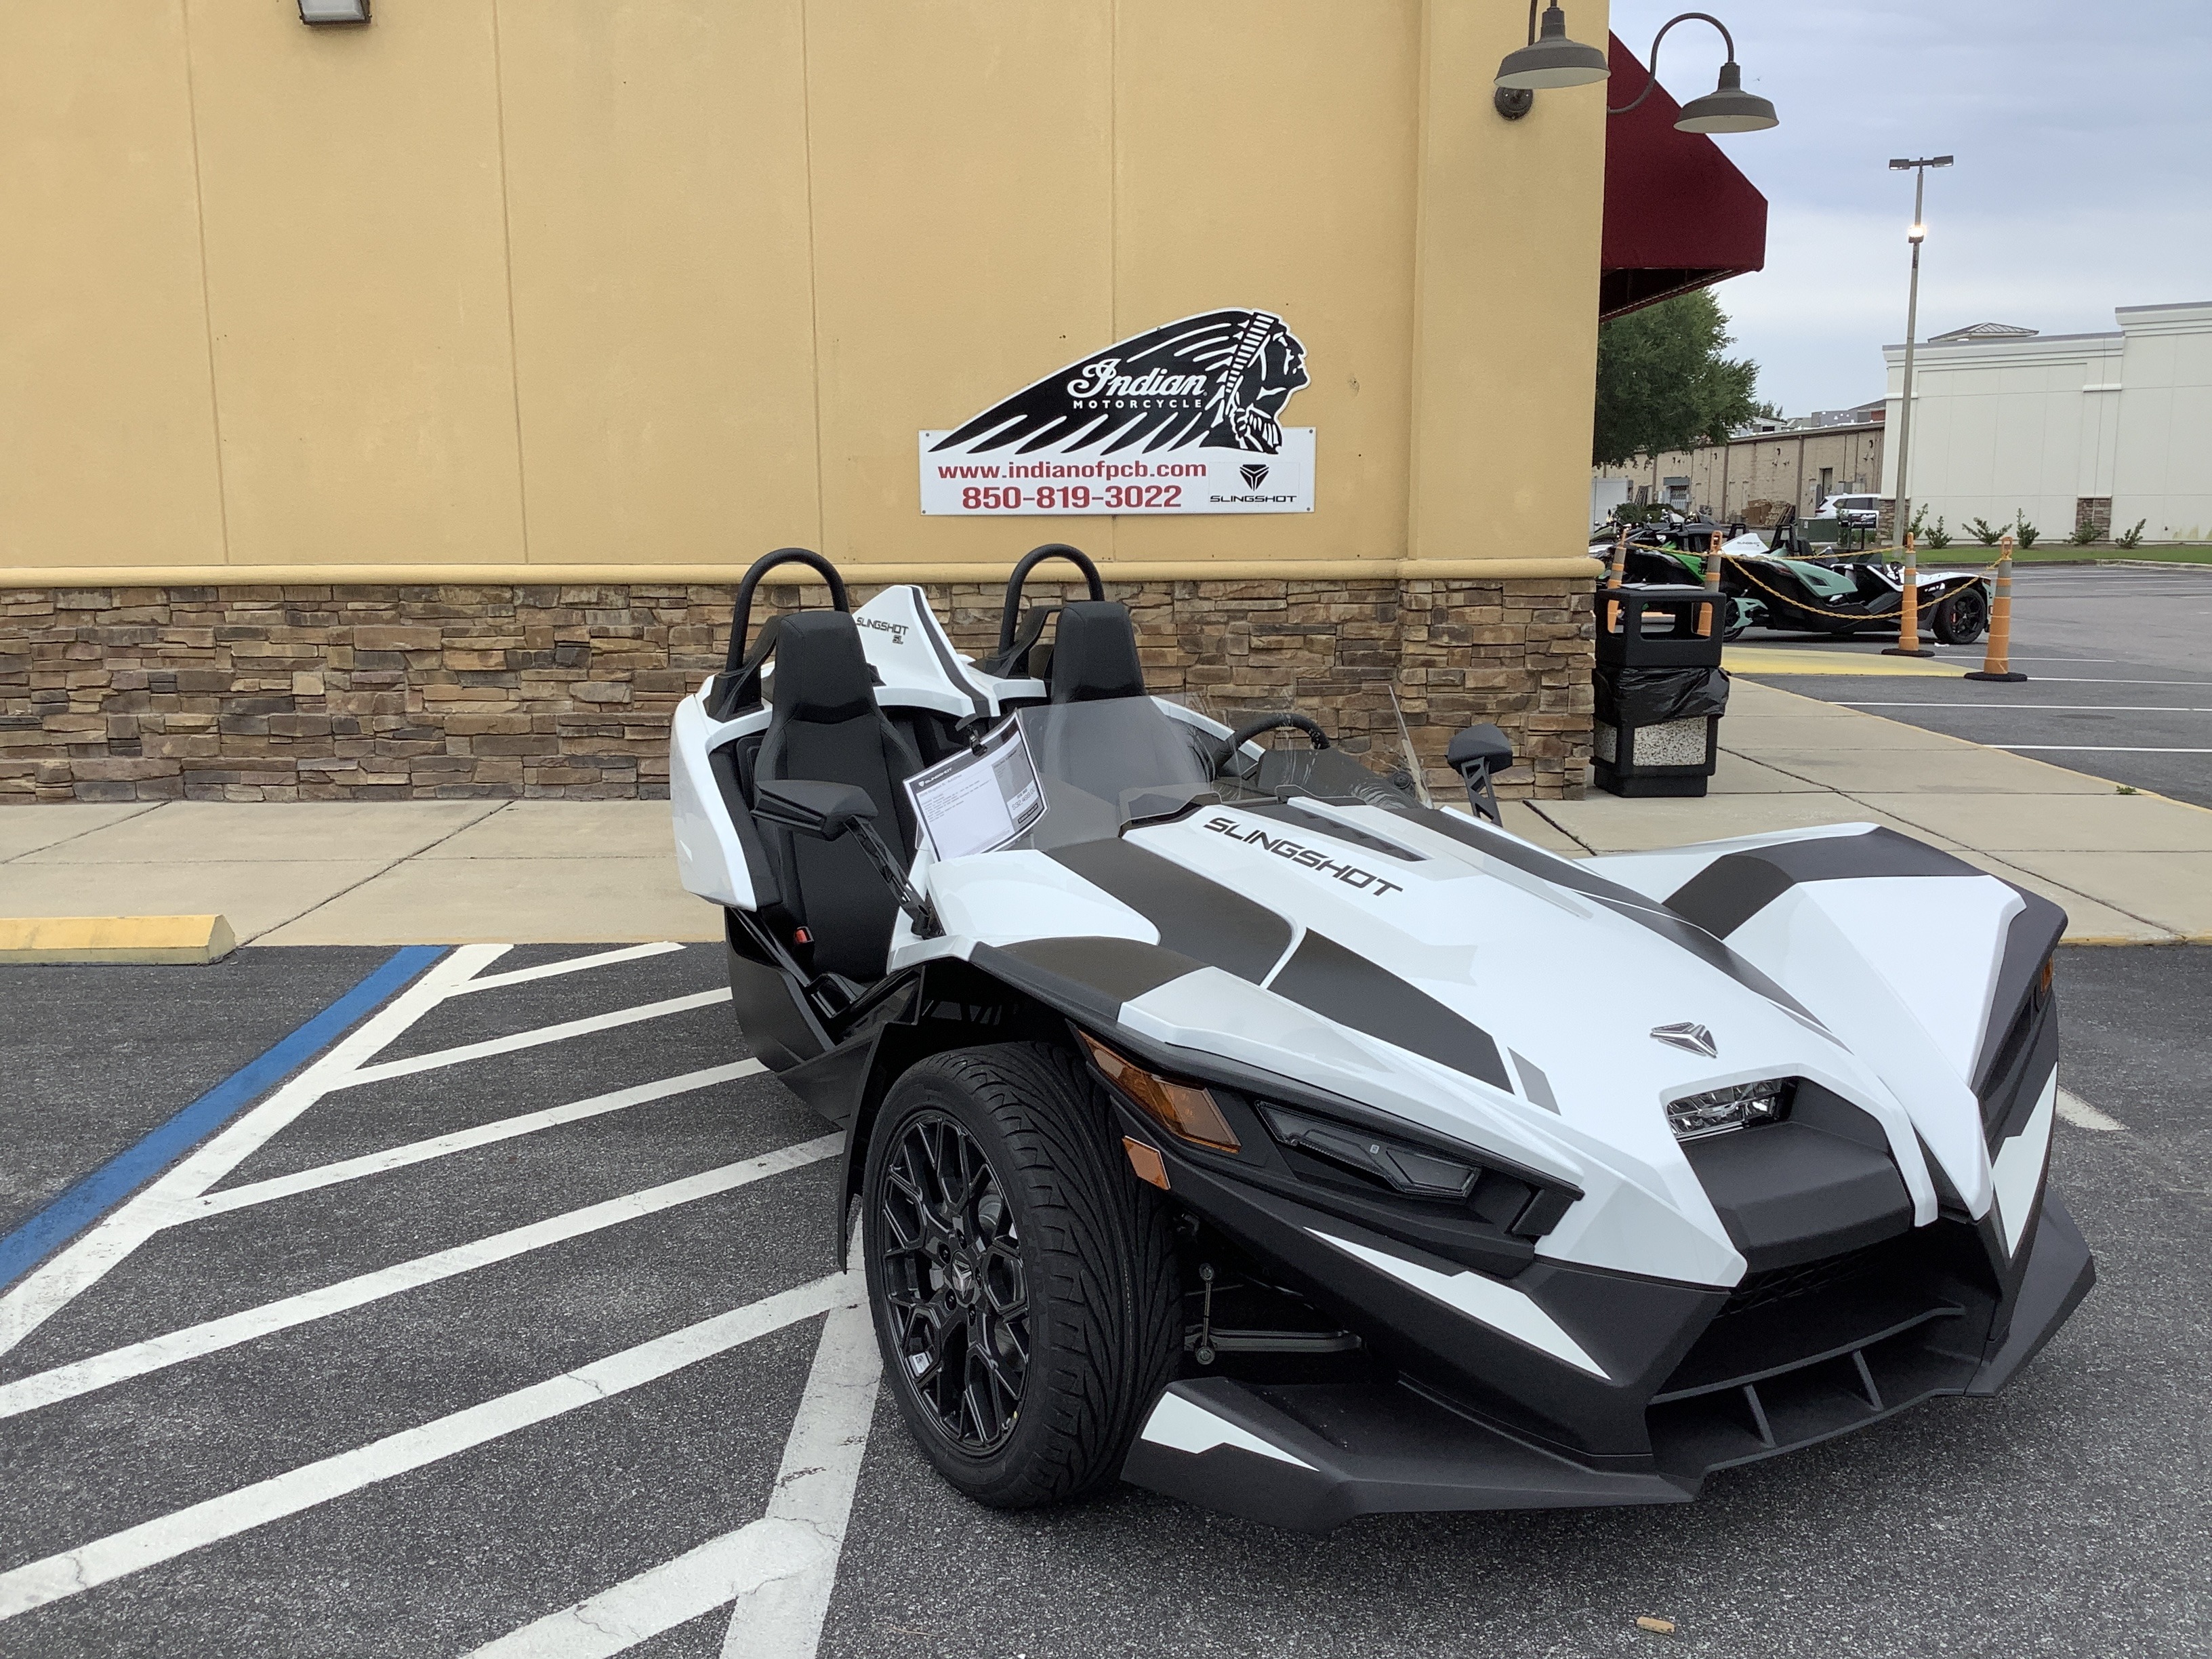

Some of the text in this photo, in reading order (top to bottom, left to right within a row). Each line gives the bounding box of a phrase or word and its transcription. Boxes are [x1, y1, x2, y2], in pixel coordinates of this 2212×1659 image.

[1067, 358, 1208, 398] Indian
[1073, 398, 1202, 409] MOTORCYCLE
[938, 460, 1207, 480] www.indianofpcb.com
[962, 485, 1182, 509] 850-819-3022
[1210, 495, 1297, 503] SLINGSHOT
[856, 617, 909, 636] SLINGSHOT
[1203, 817, 1404, 897] SLINGSHOT
